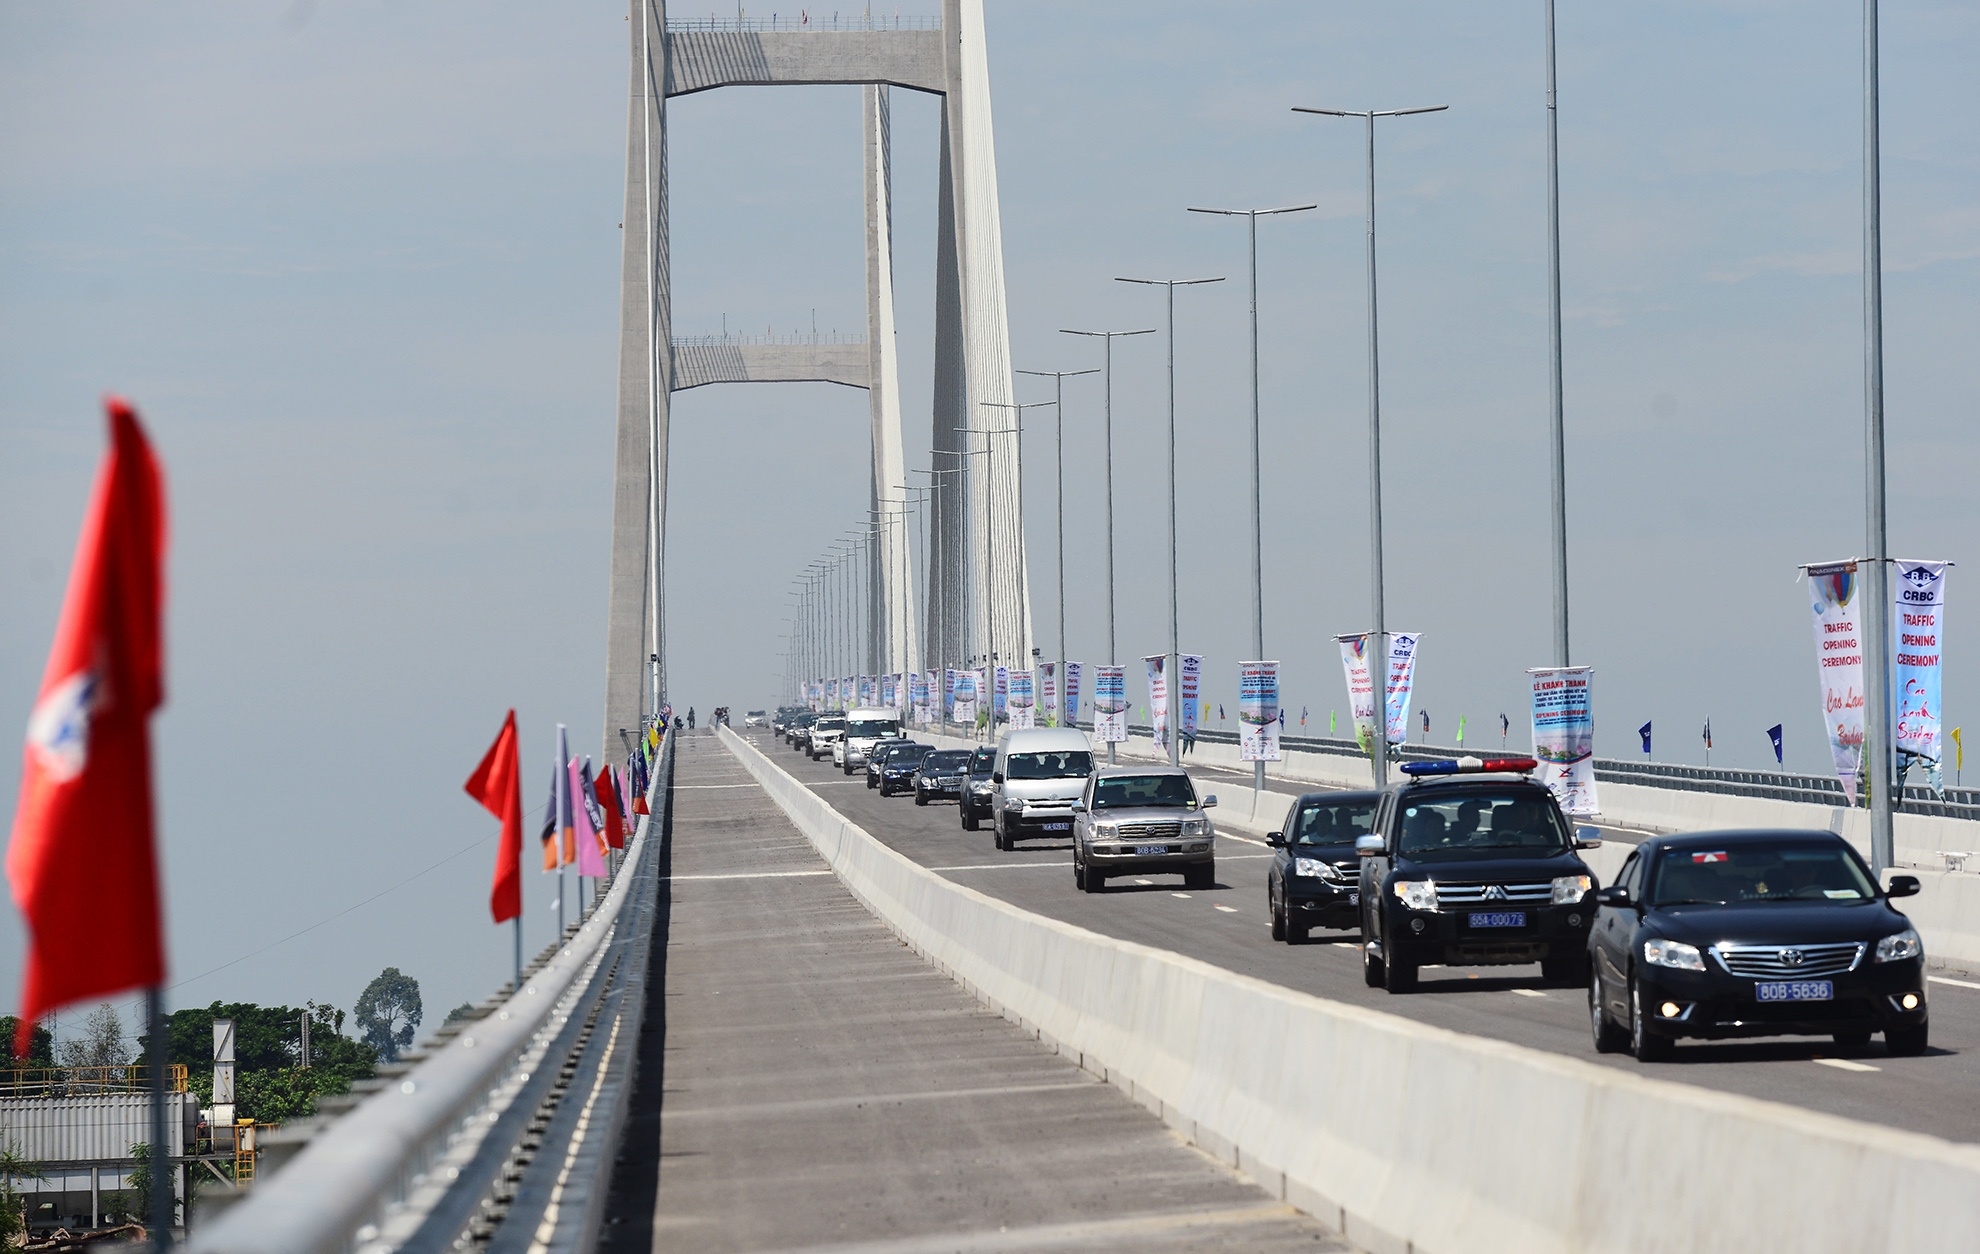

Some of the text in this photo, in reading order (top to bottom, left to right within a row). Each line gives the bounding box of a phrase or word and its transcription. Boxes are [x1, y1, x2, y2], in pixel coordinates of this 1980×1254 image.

[1903, 590, 1934, 601] CRBC
[1903, 613, 1935, 626] TRAFFIC
[1824, 622, 1853, 633] TRAFFIC
[1823, 639, 1857, 650] OPENING
[1901, 633, 1936, 647] OPENING
[1822, 655, 1862, 667] CEREMONY
[1896, 653, 1940, 667] CEREMONY
